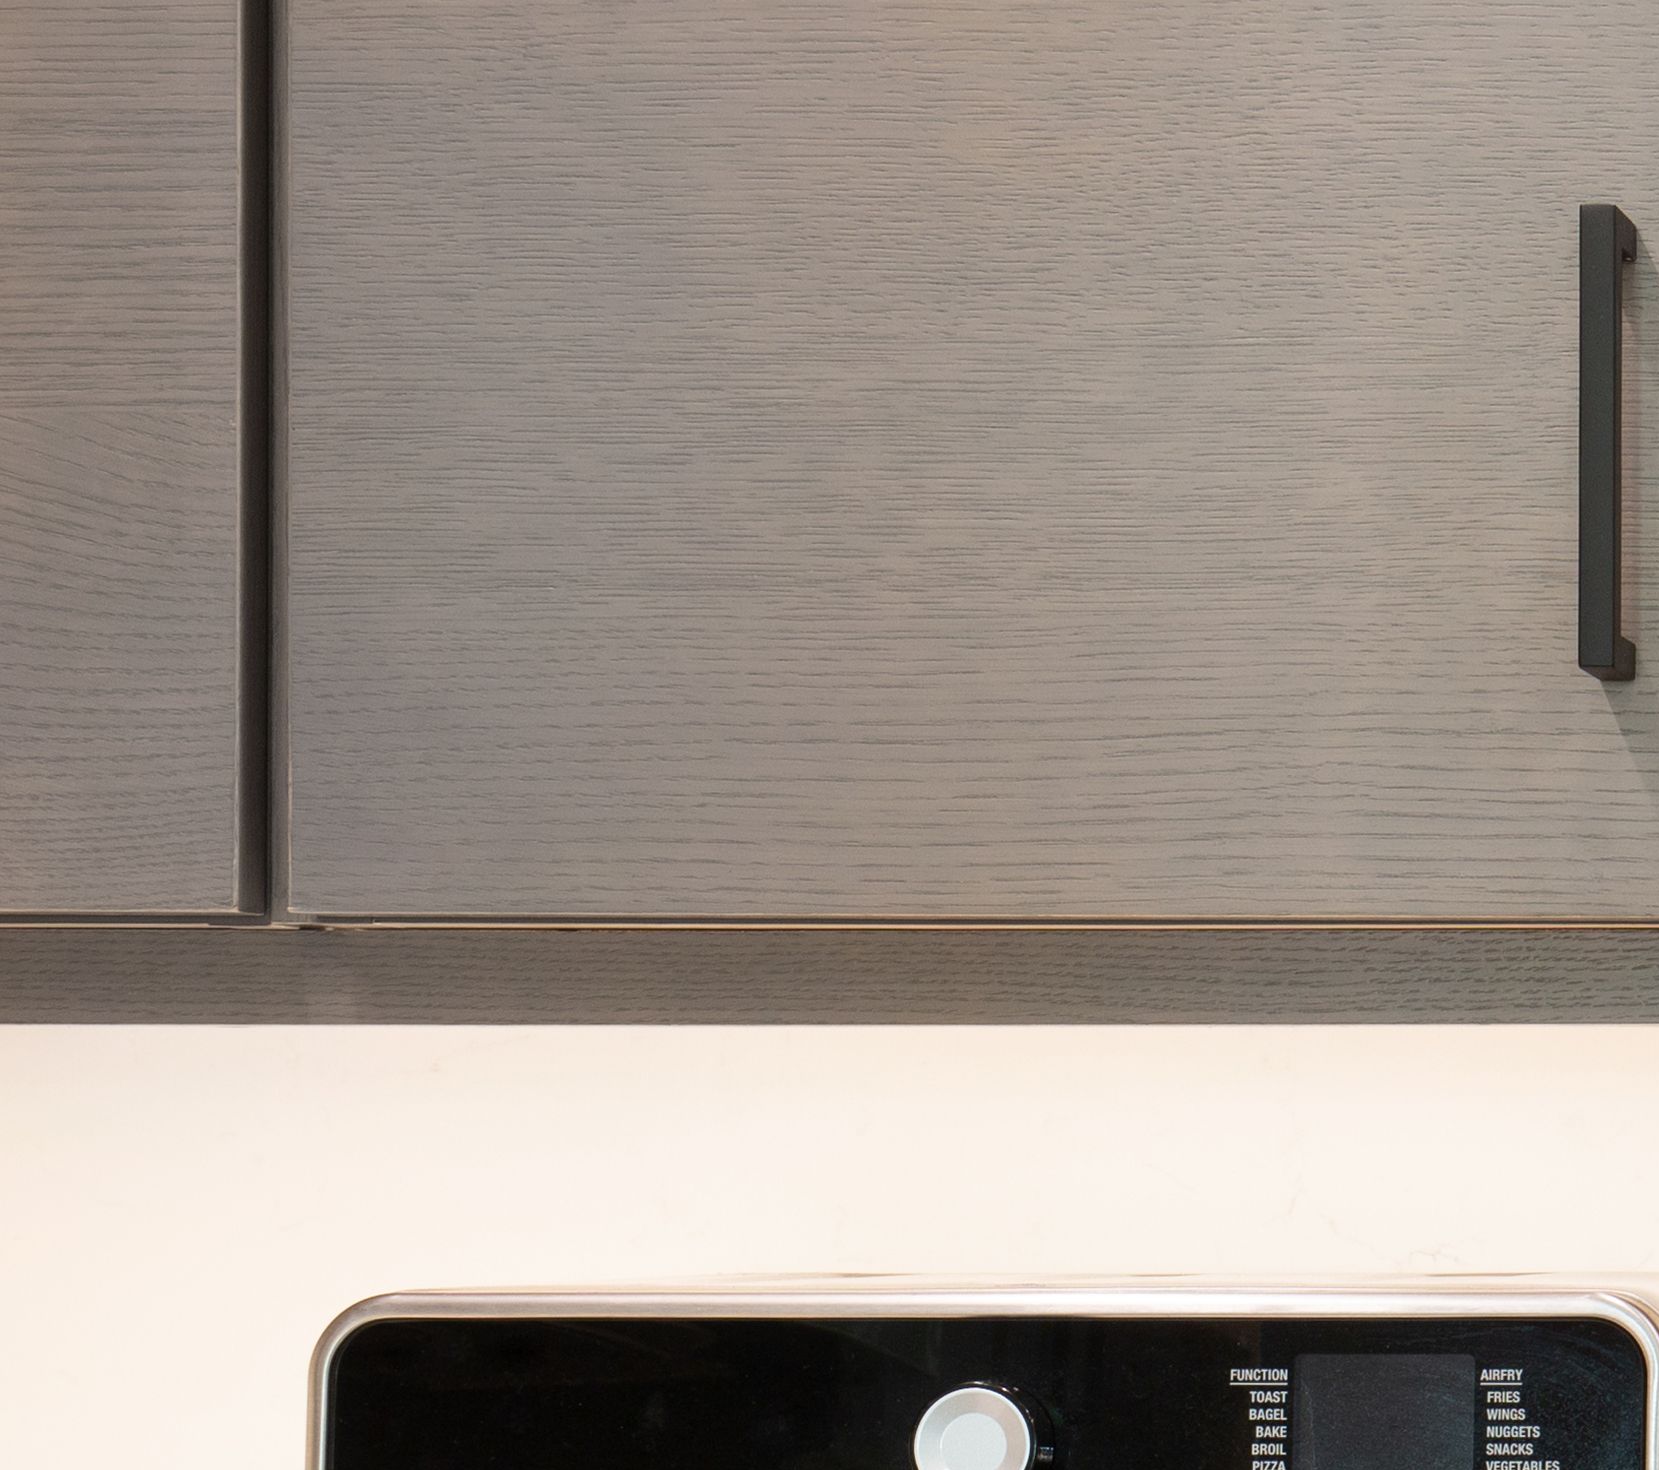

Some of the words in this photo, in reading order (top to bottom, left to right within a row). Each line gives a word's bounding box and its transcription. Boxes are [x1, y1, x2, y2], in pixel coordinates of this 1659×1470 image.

[1230, 1368, 1288, 1381] FUNCTION
[1480, 1369, 1523, 1381] AIRFRY
[1249, 1390, 1288, 1403] TOAST
[1487, 1391, 1521, 1403] FRIES
[1249, 1408, 1287, 1421] BAGEL
[1486, 1408, 1526, 1421] WINGS
[1255, 1426, 1287, 1438] BAKE
[1486, 1425, 1540, 1438] NUGGETS
[1251, 1443, 1287, 1456] BROIL
[1486, 1443, 1534, 1456] SNACKS
